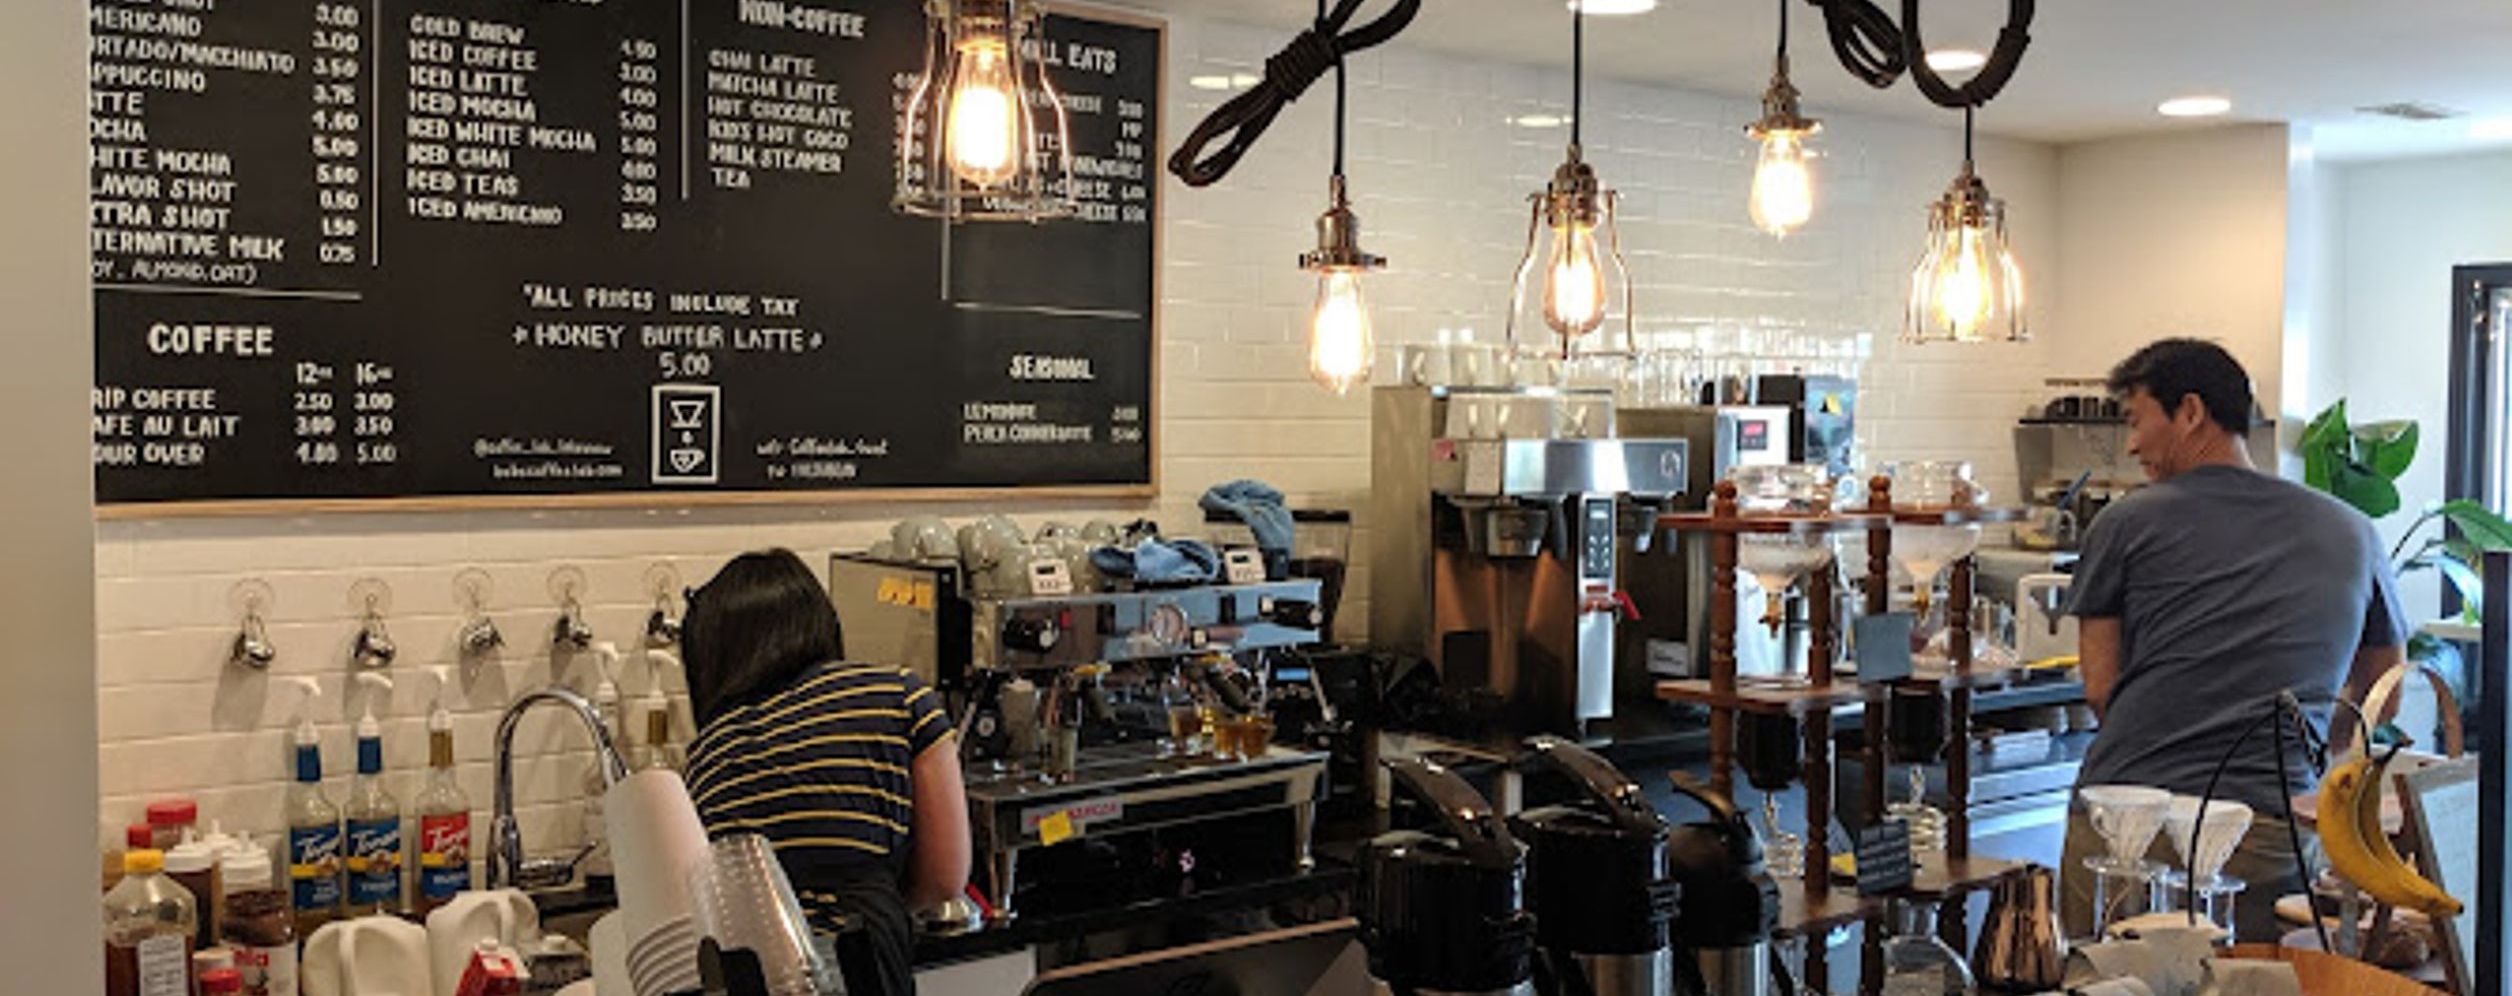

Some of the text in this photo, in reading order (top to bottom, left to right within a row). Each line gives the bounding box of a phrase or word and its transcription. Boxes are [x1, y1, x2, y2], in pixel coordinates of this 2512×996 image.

[410, 13, 526, 45] COLD BREW
[739, 0, 865, 37] NON-COFFEE
[313, 31, 359, 52] 3.00
[409, 39, 537, 71] ICED COFFEE
[708, 49, 816, 78] CHAI LATTE
[1068, 43, 1117, 75] EATS
[409, 65, 528, 97] ICED LATTE
[708, 70, 839, 104] MATCHA LATTE
[409, 90, 537, 122] ICED MOCHA
[707, 96, 853, 128] HOT CHOCOLATE
[407, 116, 597, 152] ICED WHITE MOCHA
[757, 123, 796, 144] HOT
[157, 149, 232, 176] MOCHA
[407, 143, 511, 169] ICED CHAI
[707, 141, 842, 173] MILK STEAMER
[169, 178, 237, 202] SHOT
[407, 168, 519, 197] ICED TEAS
[711, 167, 752, 189] TEA
[162, 204, 231, 229] SHOT
[408, 197, 564, 226] ICED AMERICANO
[229, 235, 285, 261] MILK
[585, 286, 653, 312] PRICES
[670, 294, 750, 316] INCLUDE
[761, 298, 799, 316] TAX
[148, 322, 274, 355] COFFEE
[534, 322, 803, 353] HONEY BUTTER LATTE
[659, 351, 711, 379] 5.00
[132, 388, 217, 410] COFFEE
[143, 415, 174, 437] AU
[183, 415, 241, 439] LAIT
[143, 442, 205, 466] OVER
[356, 442, 397, 465] 5.00
